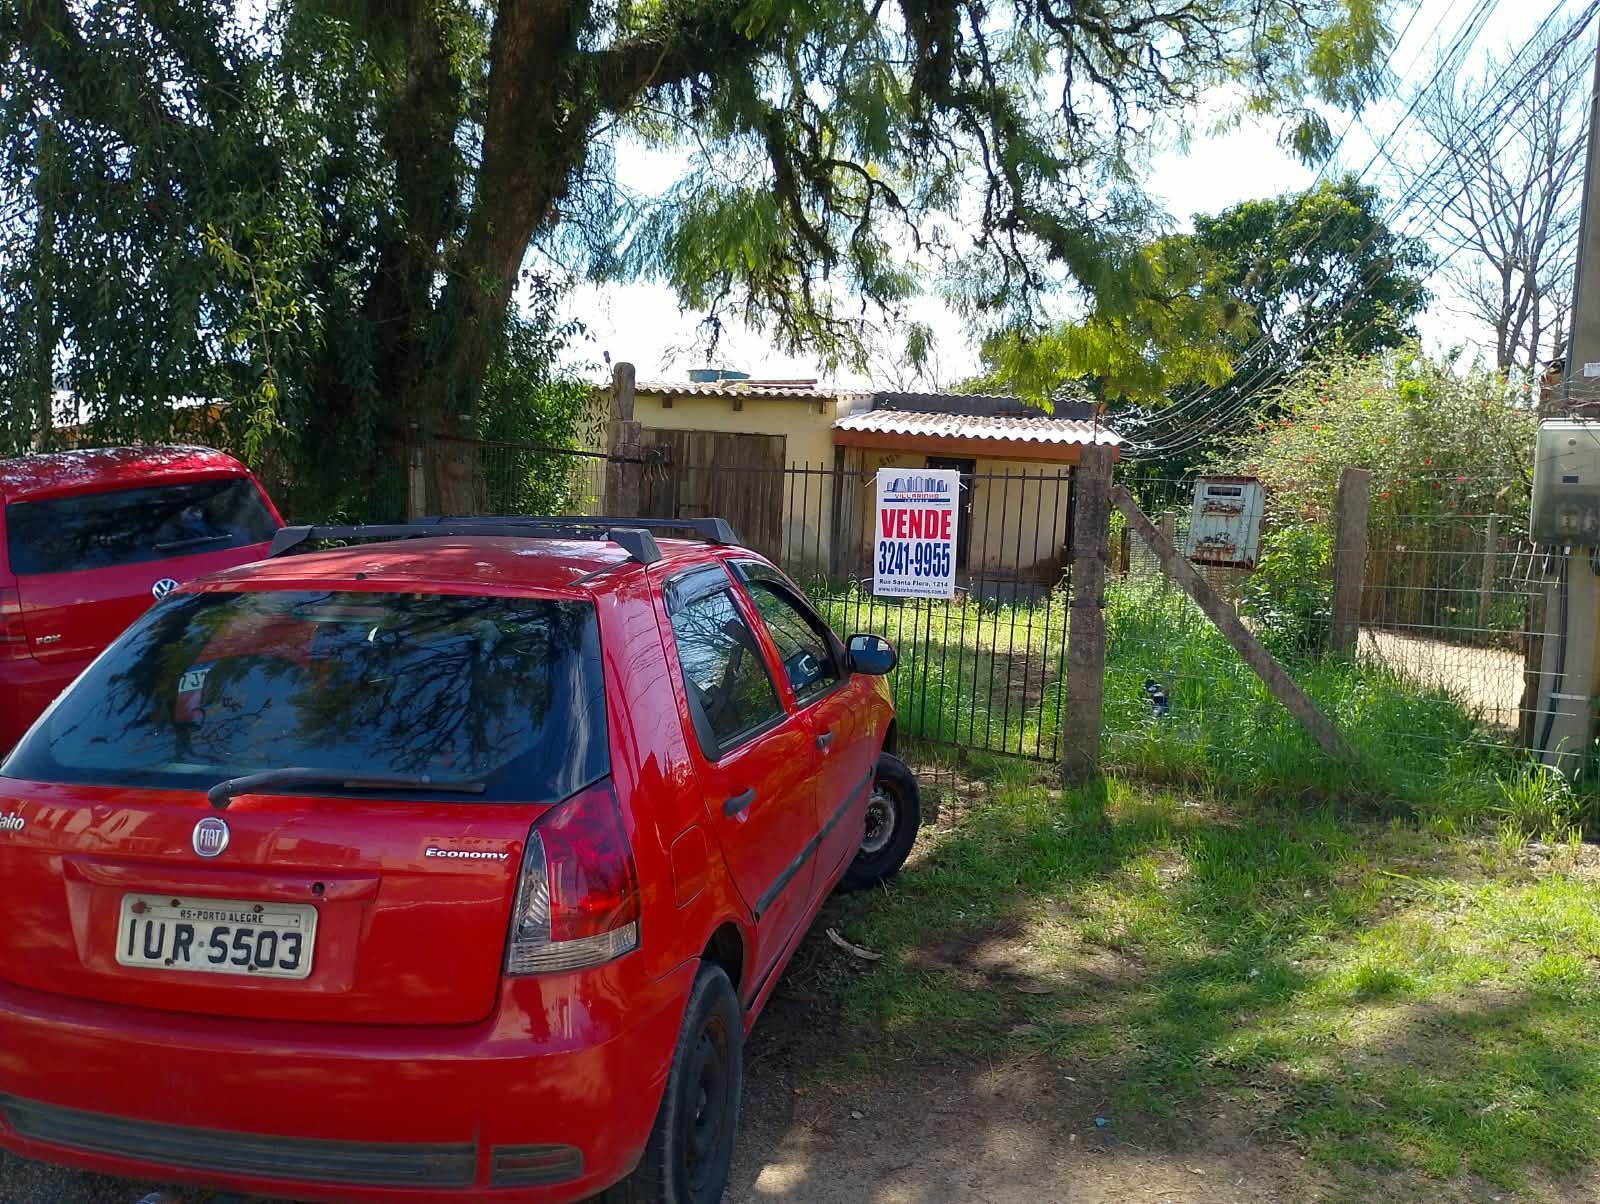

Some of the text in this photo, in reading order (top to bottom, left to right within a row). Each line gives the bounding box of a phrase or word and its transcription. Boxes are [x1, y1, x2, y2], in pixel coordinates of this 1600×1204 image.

[881, 508, 953, 540] VENDE
[878, 541, 951, 578] 3241-9955
[0, 811, 25, 831] alio
[200, 828, 222, 847] FIAT
[425, 847, 510, 862] Economy
[229, 911, 264, 924] ALEGRE
